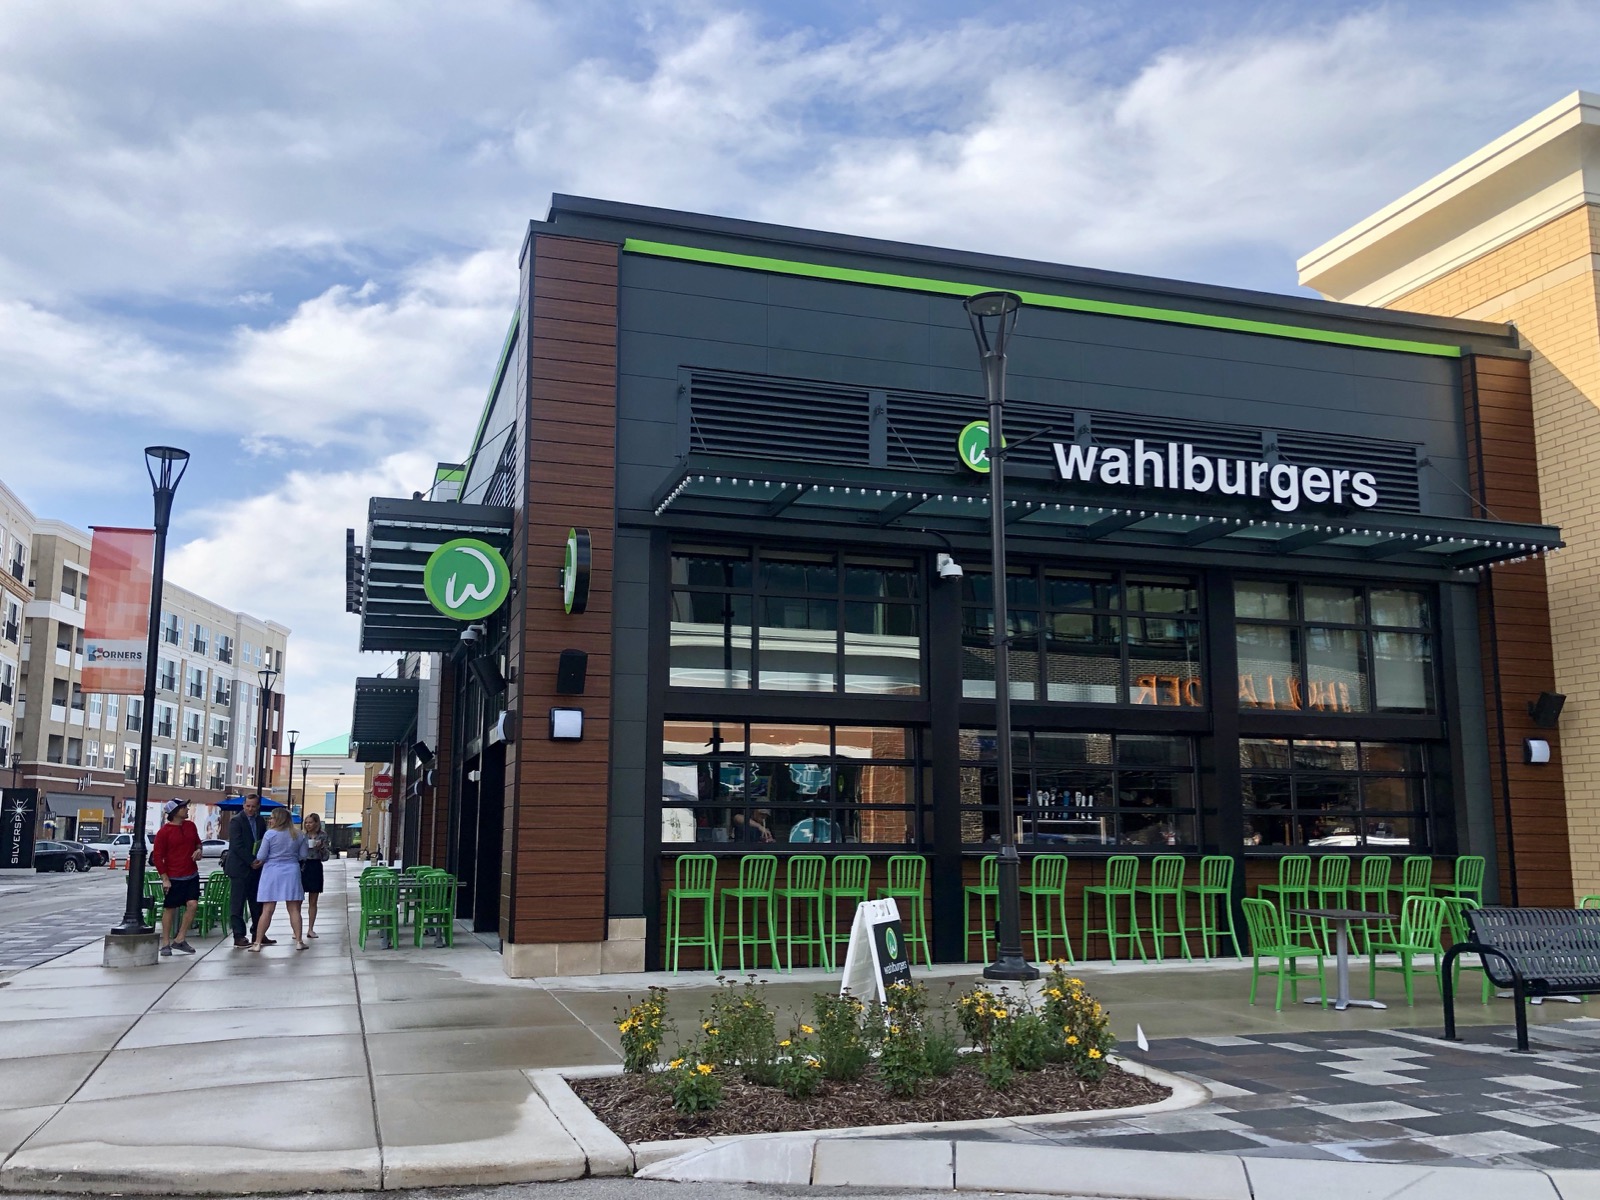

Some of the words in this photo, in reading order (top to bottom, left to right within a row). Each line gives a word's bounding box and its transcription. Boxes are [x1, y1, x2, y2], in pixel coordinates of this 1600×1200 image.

[1053, 438, 1378, 512] wahlburgers
[92, 649, 142, 659] CORNERS
[11, 799, 24, 864] SILVERSPT
